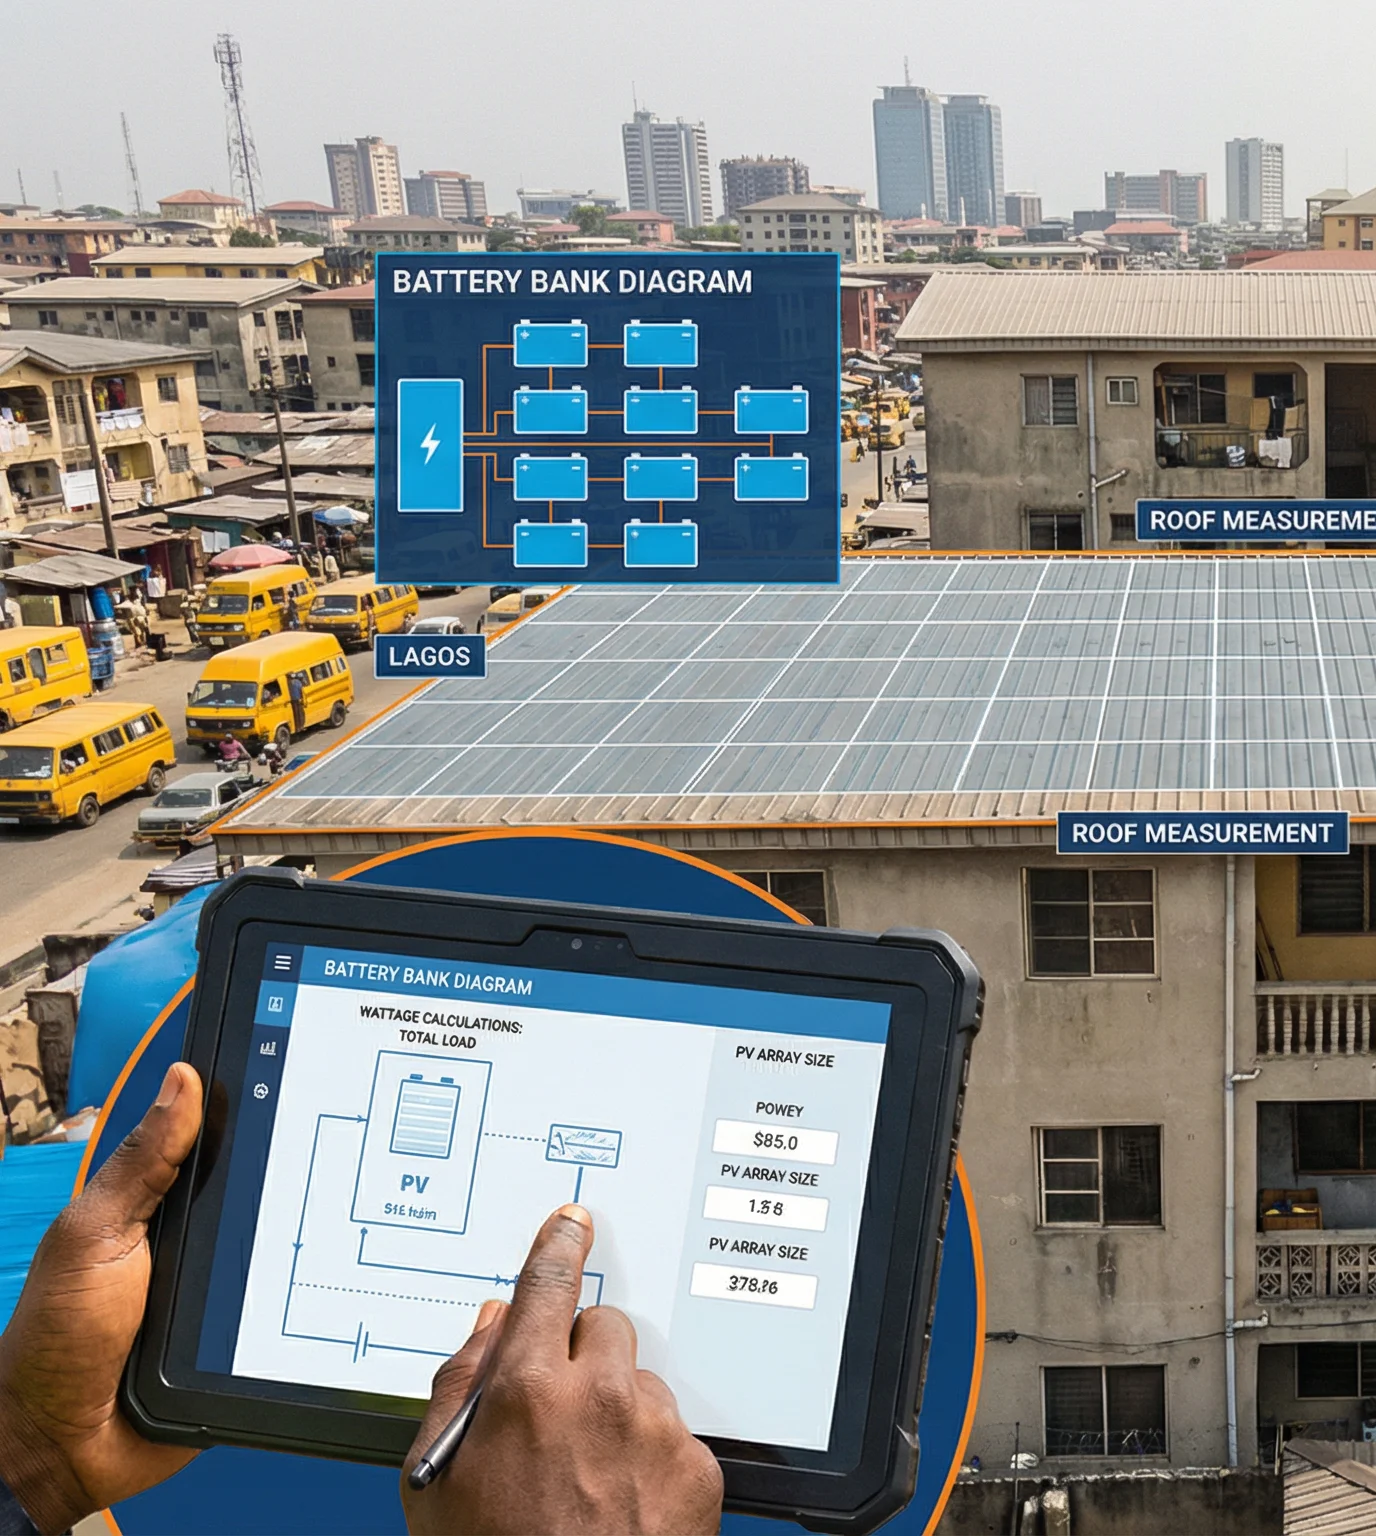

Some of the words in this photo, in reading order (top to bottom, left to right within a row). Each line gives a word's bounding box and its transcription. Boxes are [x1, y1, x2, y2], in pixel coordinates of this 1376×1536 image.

[324, 960, 400, 983] BATTERY
[402, 967, 450, 988] BANK
[453, 972, 533, 996] DIAGRAM
[360, 1005, 420, 1024] WATTAGE
[422, 1012, 523, 1034] CALCULATIONS:
[399, 1029, 439, 1046] TOTAL
[442, 1033, 477, 1049] LOAD
[735, 1045, 755, 1061] PV
[757, 1048, 802, 1065] ARRAY
[804, 1053, 835, 1068] SIZE
[400, 1173, 430, 1194] PV
[721, 1164, 741, 1178] PV
[741, 1166, 786, 1184] ARRAY
[788, 1171, 819, 1187] SIZE
[709, 1237, 729, 1251] PV
[730, 1240, 776, 1257] ARRAY
[777, 1245, 809, 1261] SIZE
